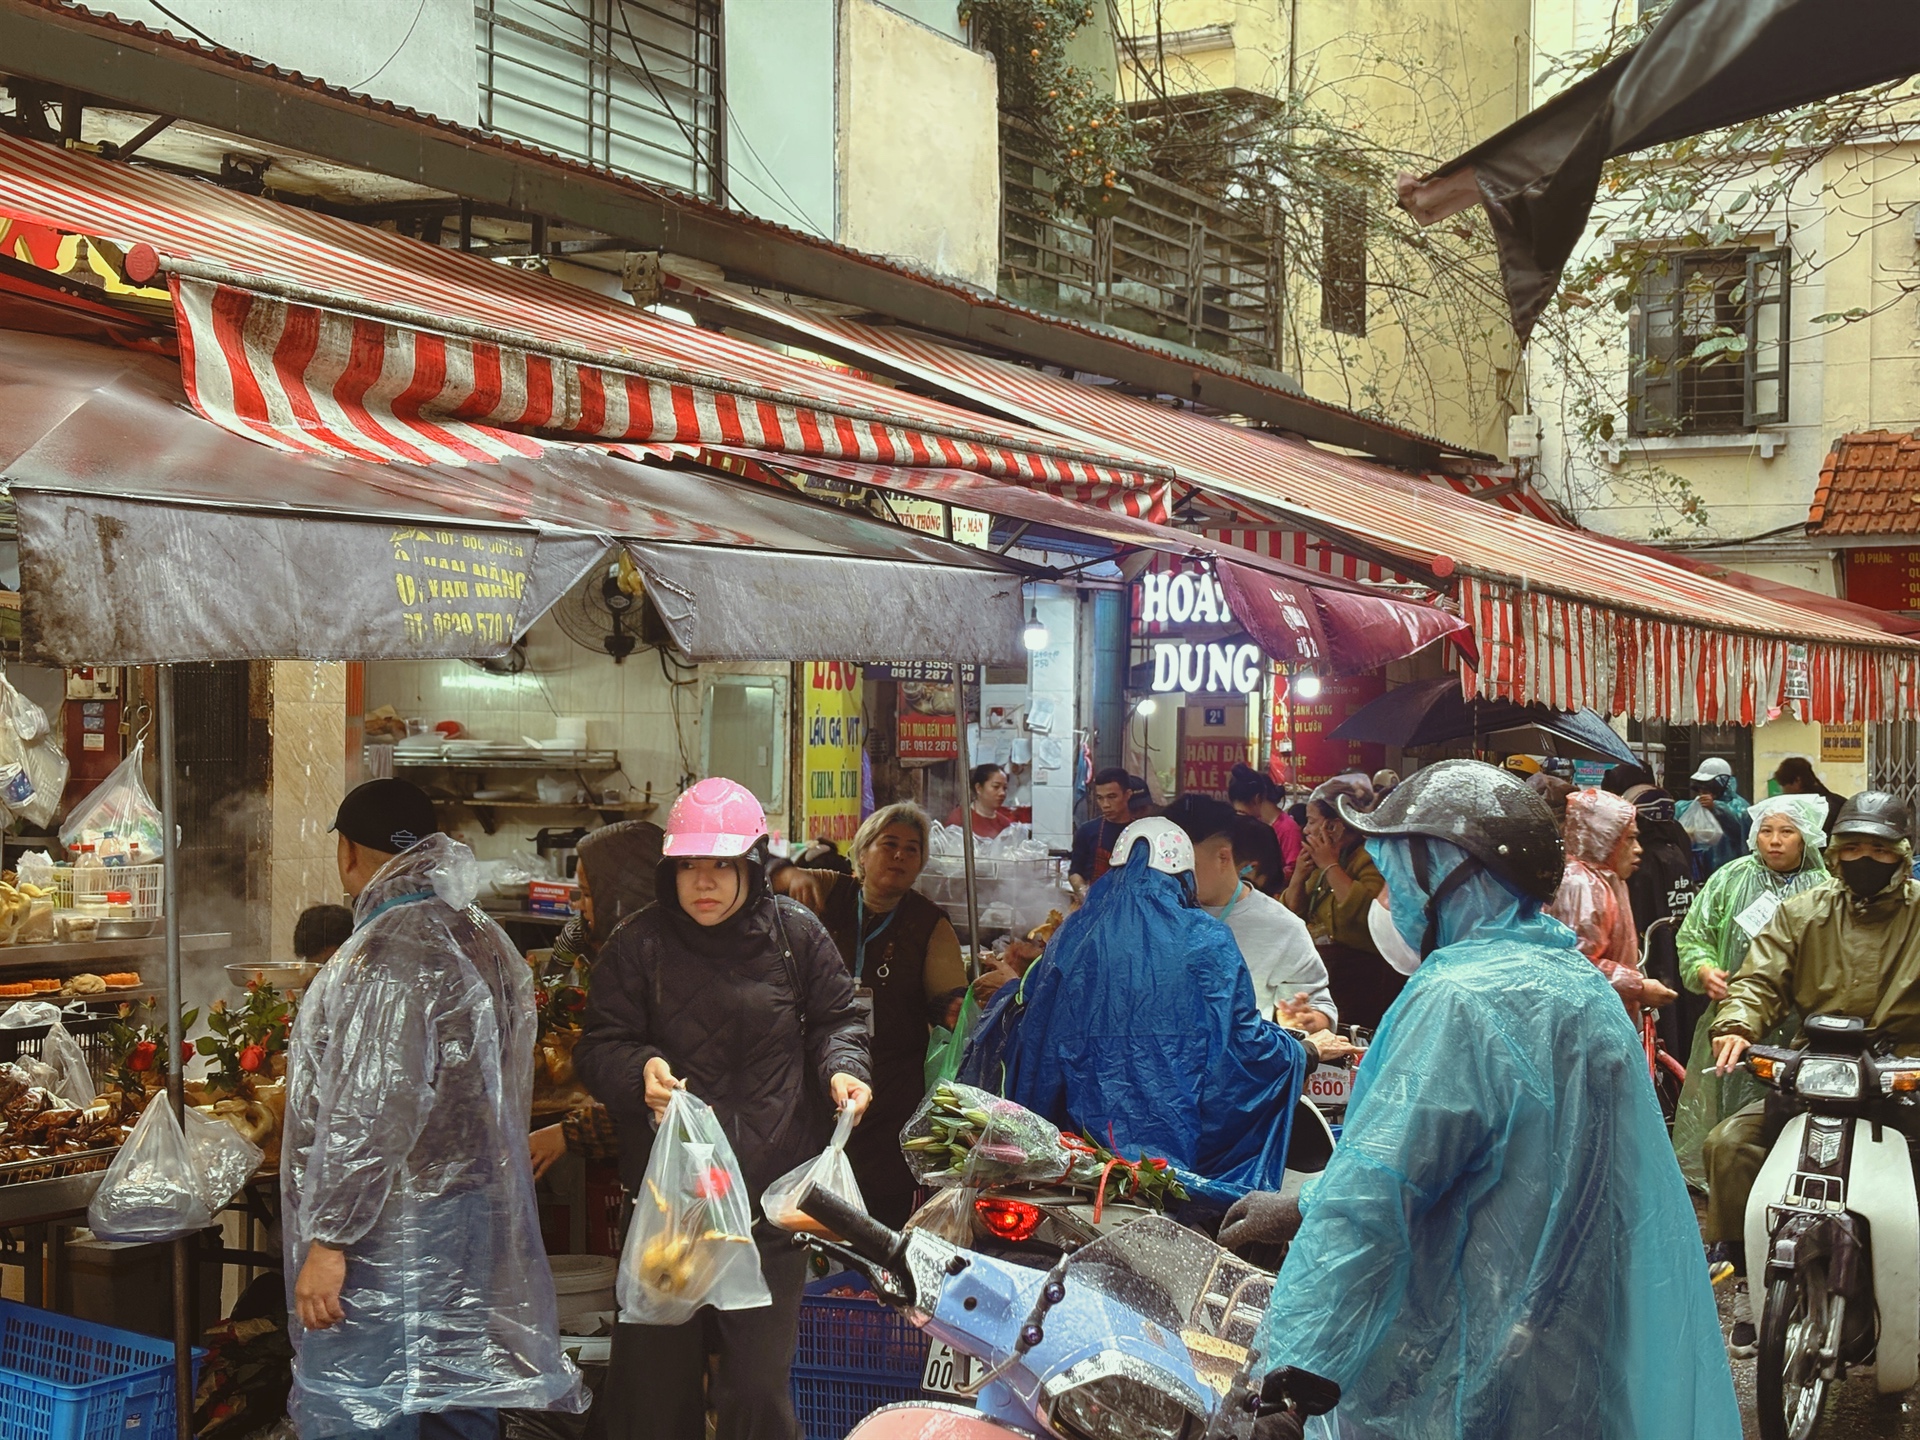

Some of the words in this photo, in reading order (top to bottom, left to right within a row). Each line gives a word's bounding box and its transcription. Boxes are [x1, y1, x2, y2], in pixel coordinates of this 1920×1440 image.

[890, 668, 921, 678] 0912
[925, 670, 948, 680] 287
[1152, 643, 1260, 694] DUNG
[846, 717, 860, 752] VỊT
[914, 740, 934, 751] 0912
[935, 740, 951, 751] 287
[811, 771, 836, 803] CHIM,
[1667, 891, 1695, 907] Zen
[1312, 1080, 1343, 1096] 600
